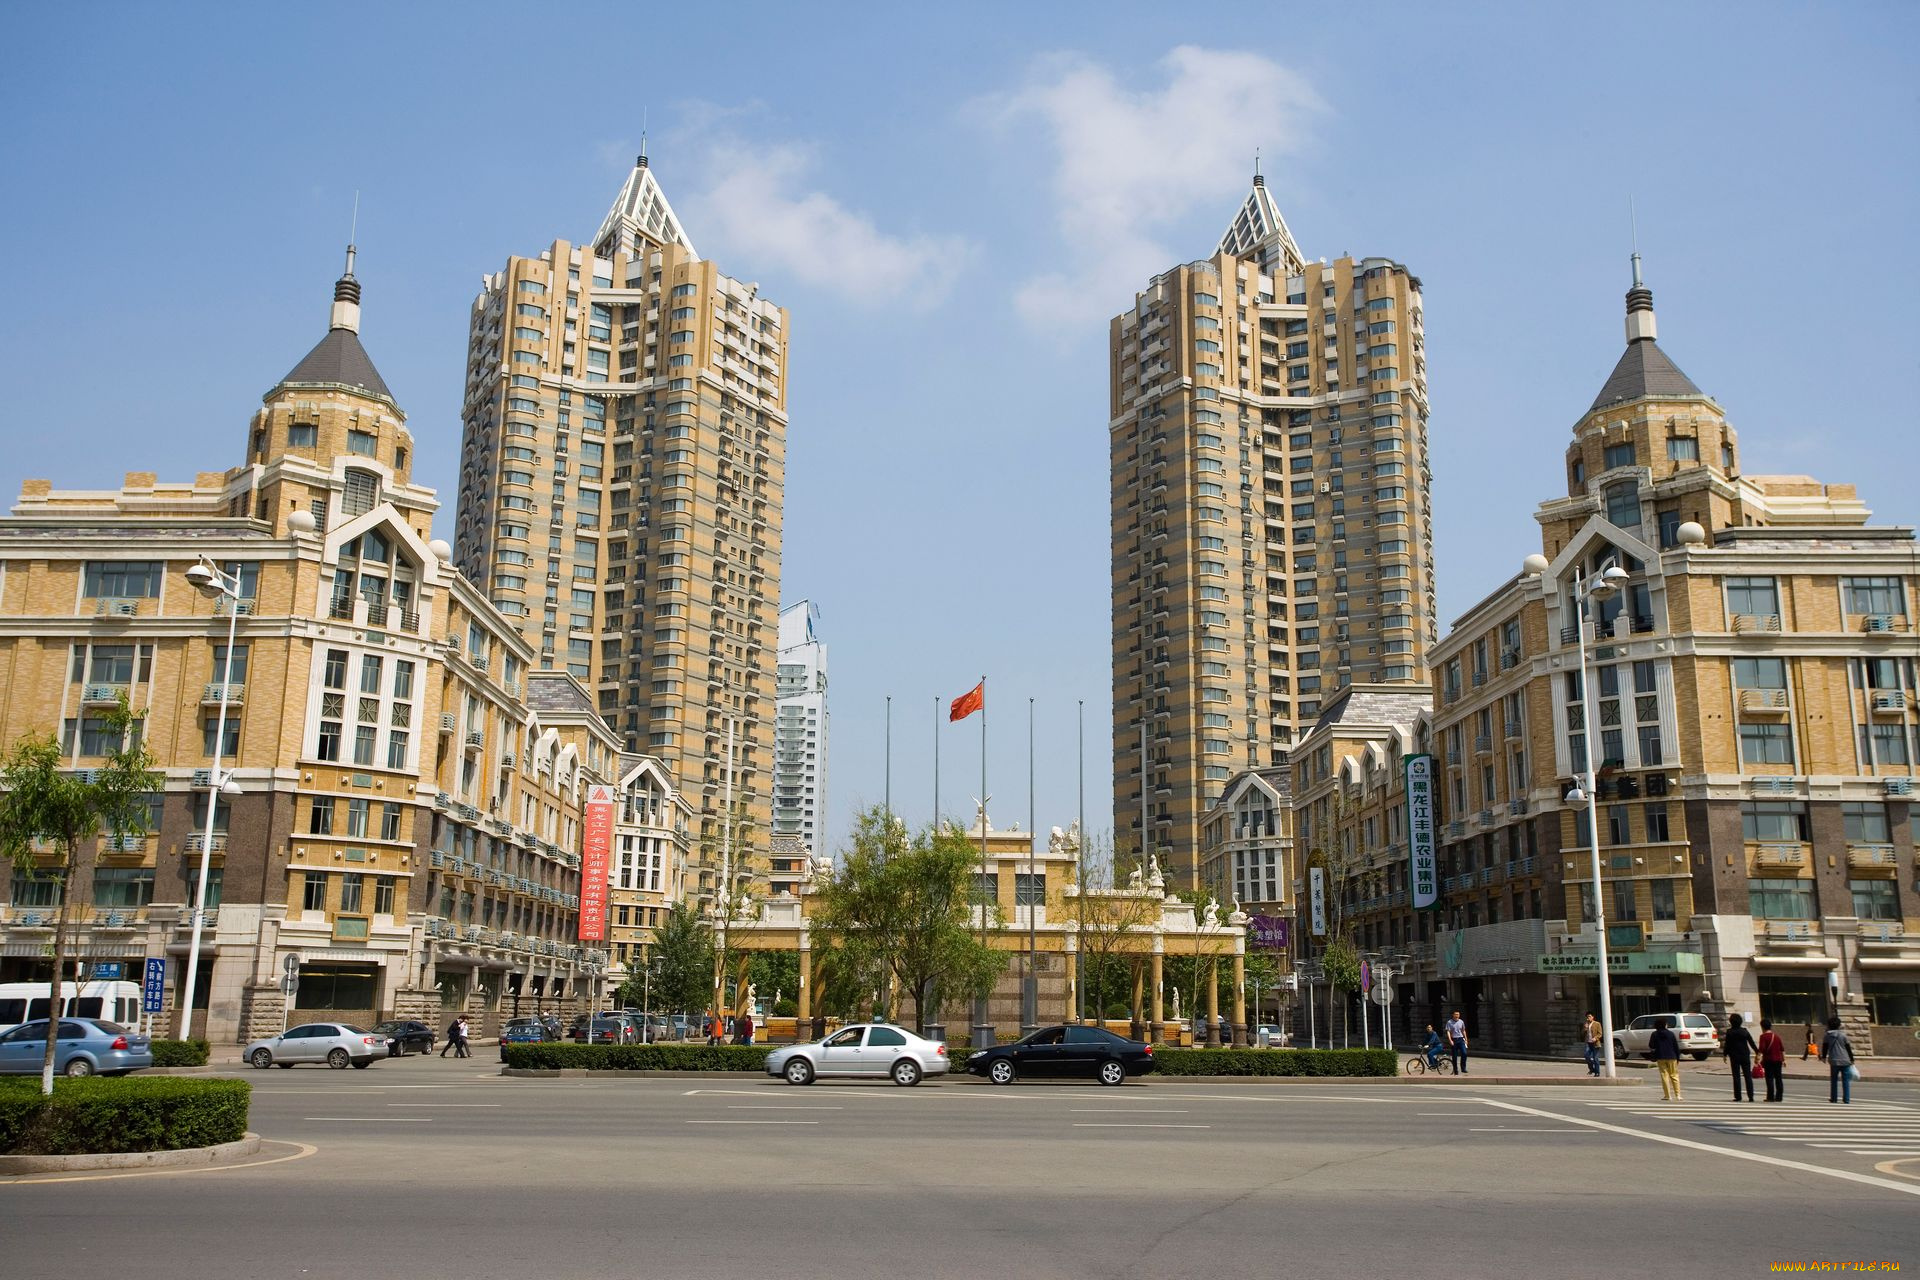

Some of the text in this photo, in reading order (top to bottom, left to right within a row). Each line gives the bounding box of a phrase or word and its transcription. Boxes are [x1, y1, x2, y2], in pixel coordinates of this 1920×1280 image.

[1413, 781, 1433, 894] 黑龙江丰德农业集团
